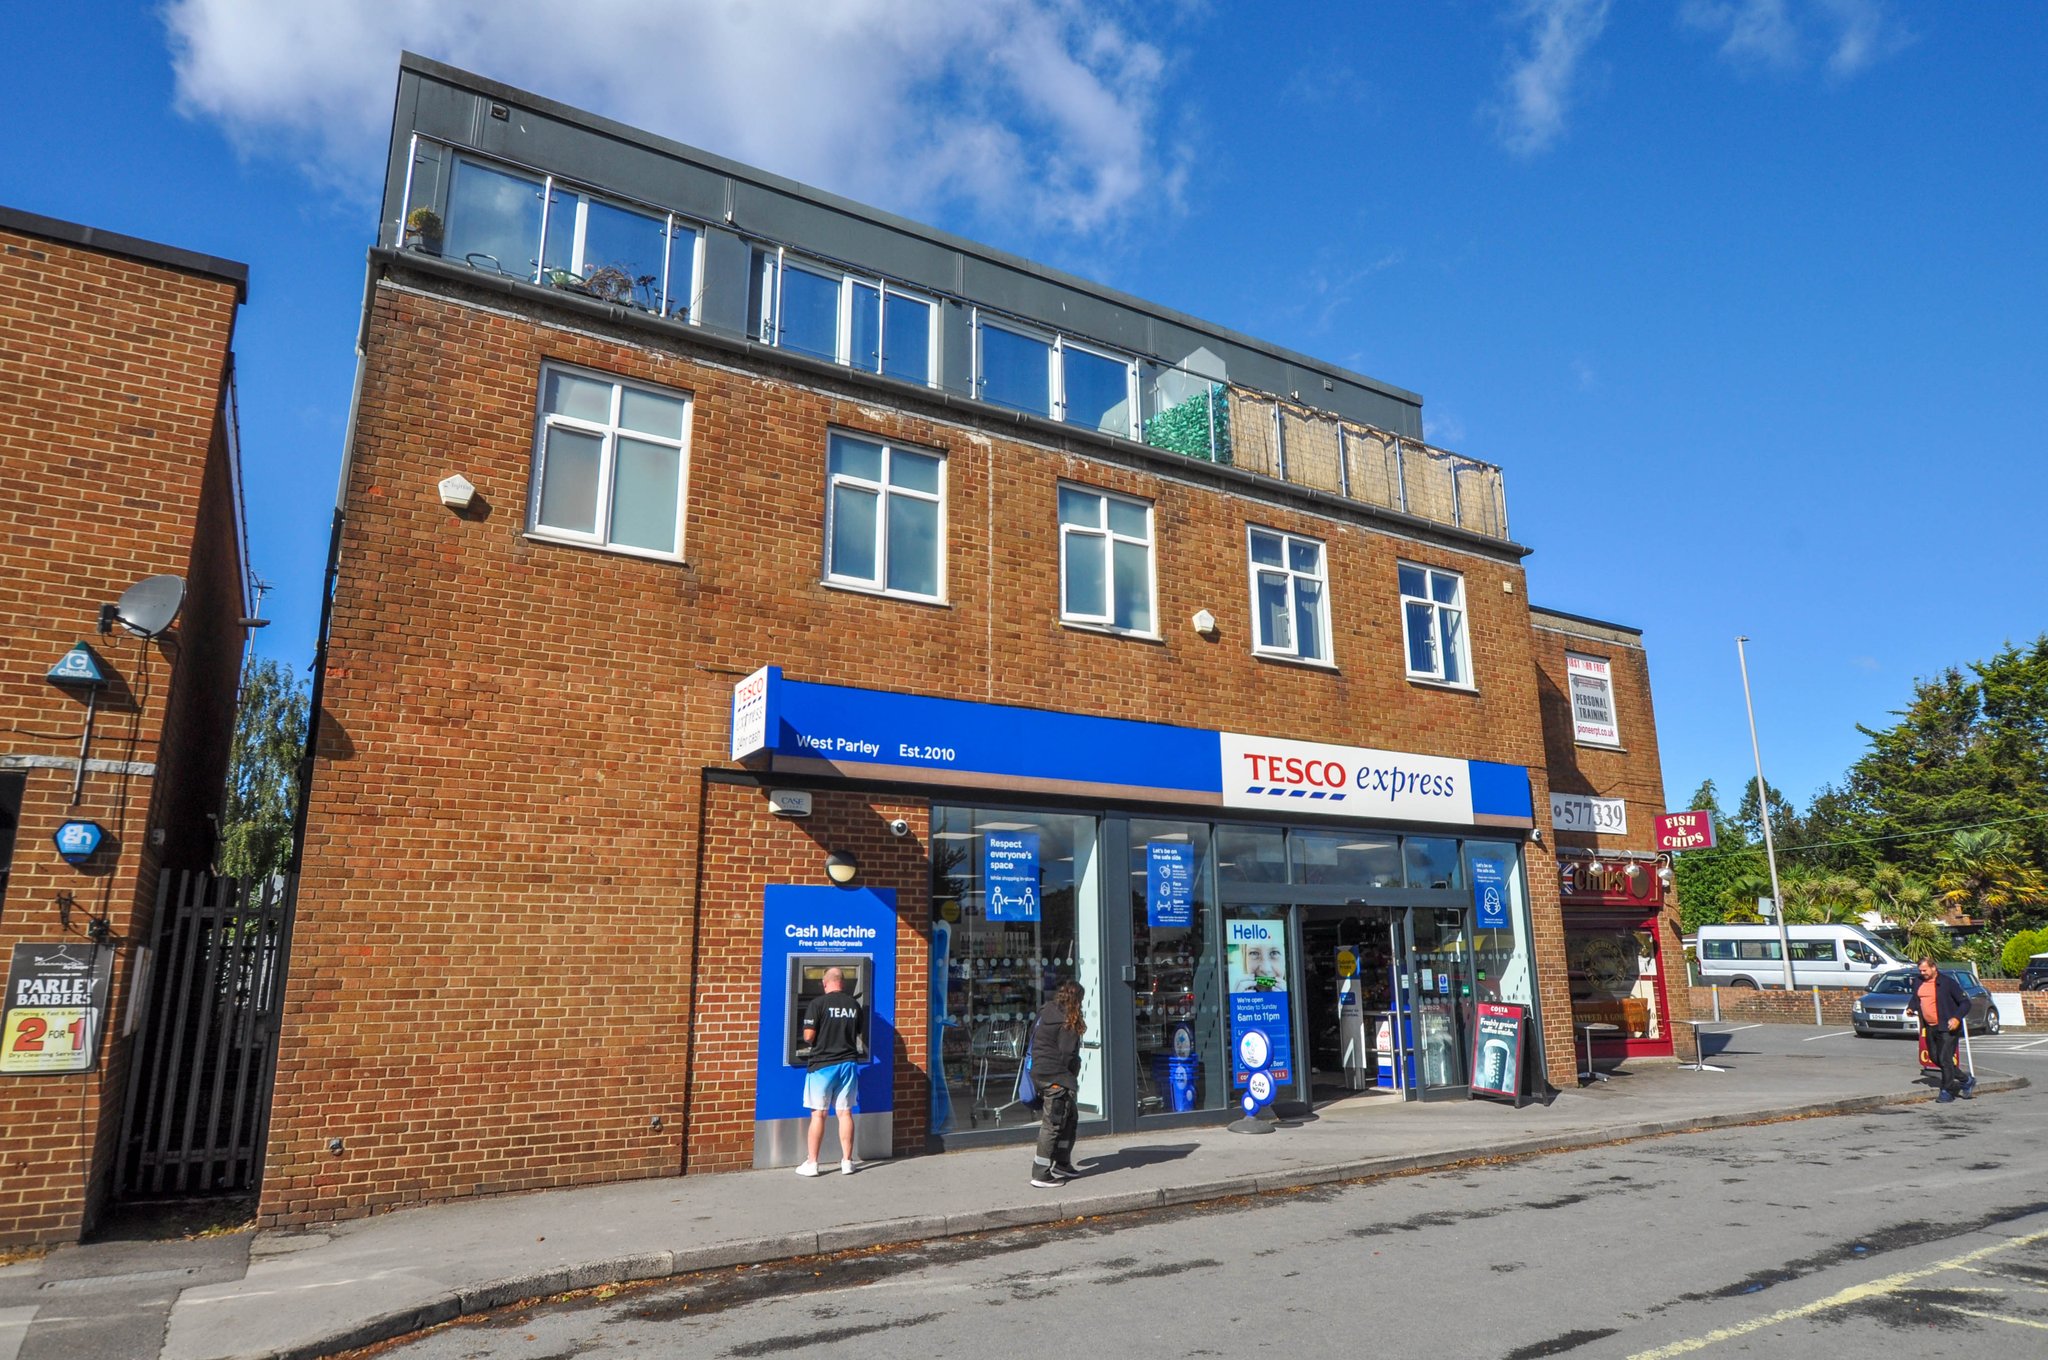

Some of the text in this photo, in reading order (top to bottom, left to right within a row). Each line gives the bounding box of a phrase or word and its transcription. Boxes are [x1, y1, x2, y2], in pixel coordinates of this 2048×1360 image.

[57, 667, 93, 678] Chubb
[738, 677, 763, 704] TESCO
[1575, 693, 1608, 709] PERSONAL
[1578, 707, 1609, 722] TRAINING
[1577, 724, 1615, 737] pioneerpt.co.uk
[796, 734, 956, 762] West Parley Est.2010
[1243, 753, 1454, 802] TESCO express
[1664, 815, 1696, 829] FISH
[1677, 827, 1687, 836] &
[990, 838, 1023, 850] Respect
[1662, 832, 1704, 848] CHIPS
[990, 851, 1033, 861] everyone's
[1152, 847, 1164, 855] Let's
[990, 861, 1014, 871] space
[1573, 867, 1627, 892] CHIPS
[785, 924, 877, 939] Cash Machine
[1233, 924, 1271, 940] Hello.
[798, 939, 813, 947] Free
[16, 978, 99, 994] PARLEY
[16, 993, 92, 1006] BARBERS
[1490, 1005, 1509, 1013] COSTA
[1237, 1012, 1281, 1022] 6am to 11pm
[1480, 1017, 1499, 1028] Freshly
[12, 1017, 86, 1052] 2 FOR 1
